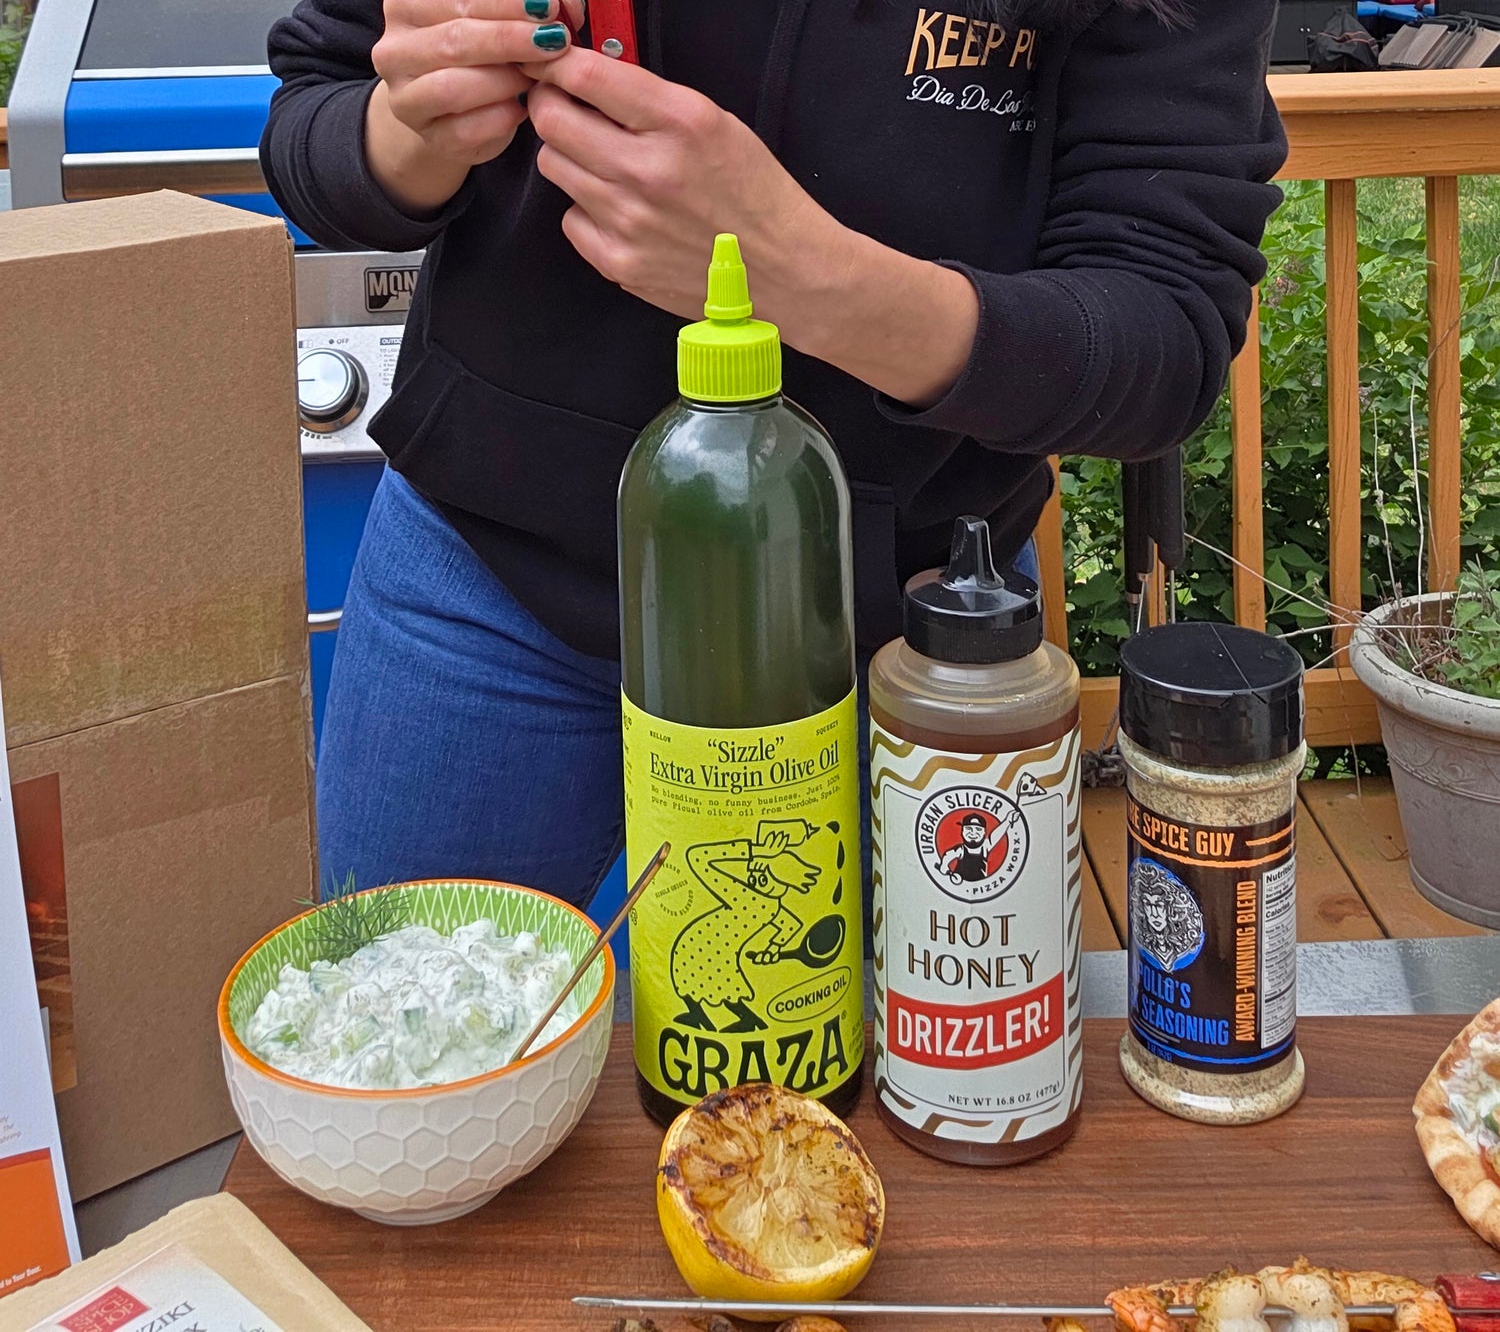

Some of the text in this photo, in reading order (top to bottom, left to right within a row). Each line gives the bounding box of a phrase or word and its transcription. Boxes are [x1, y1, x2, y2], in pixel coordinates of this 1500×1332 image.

[904, 8, 1006, 76] KEEP
[906, 74, 955, 106] Dia
[956, 84, 990, 111] De
[990, 89, 1021, 115] Los
[650, 739, 839, 795] Extra Virgin Olive Oil
[707, 736, 784, 763] “Sizzle”
[651, 796, 667, 807] pure
[707, 809, 733, 817] olive
[738, 808, 754, 816] oil
[761, 806, 782, 815] from
[662, 787, 702, 806] blending,
[725, 799, 752, 808] funny
[757, 792, 801, 806] business.
[806, 783, 823, 795] Just
[921, 792, 1003, 855] URBAN SLICER
[1142, 812, 1190, 852] SPICE
[1195, 830, 1235, 857] GUY
[972, 836, 1021, 895] PIZZA WORX
[929, 910, 1017, 948] HOT
[908, 942, 1041, 990] HONEY
[1236, 880, 1256, 1042] AWARD-WINNING BLEND
[775, 974, 848, 1014] COOKING OIL
[897, 994, 1050, 1058] DRIZZLER!
[1141, 994, 1229, 1046] SEASONING
[659, 1015, 849, 1098] GRAZA
[948, 1094, 969, 1106] NET
[973, 1098, 991, 1106] WT
[996, 1096, 1015, 1106] 16.8
[1018, 1092, 1031, 1102] OZ
[74, 1295, 127, 1328] SPICE
[136, 1300, 196, 1332] ZIKI
